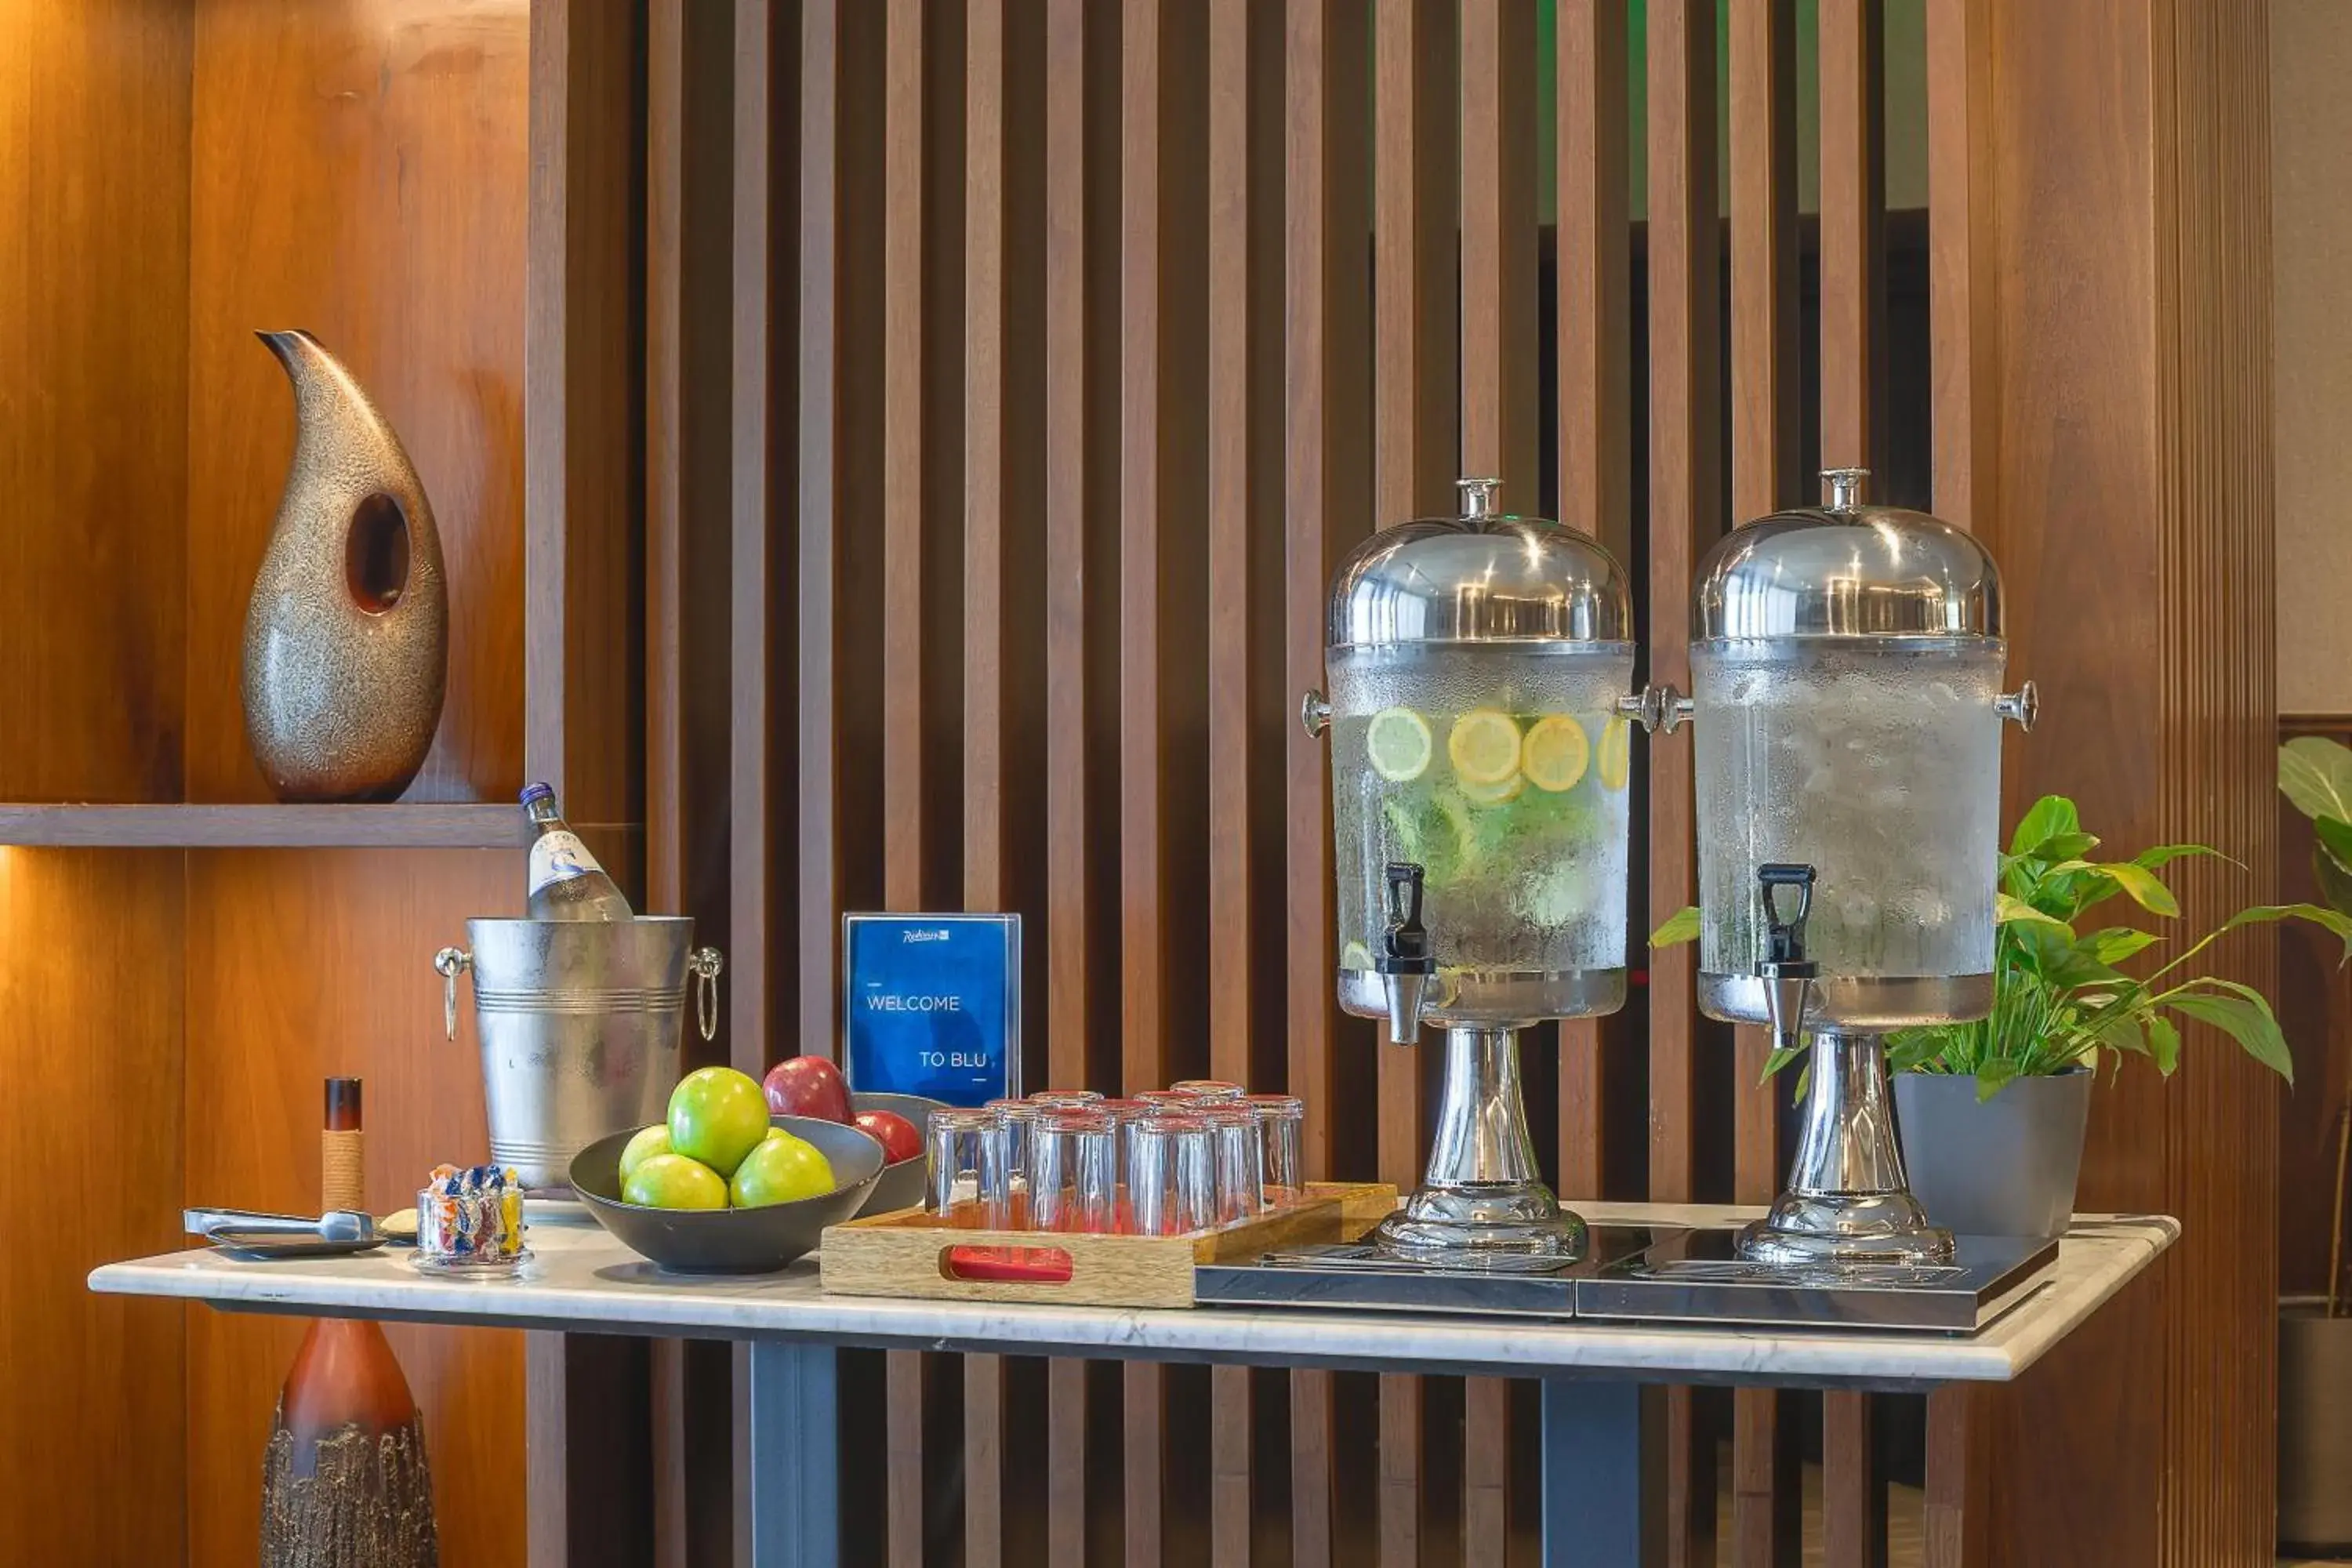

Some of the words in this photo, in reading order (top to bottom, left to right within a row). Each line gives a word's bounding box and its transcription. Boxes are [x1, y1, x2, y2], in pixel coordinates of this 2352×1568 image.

[867, 995, 960, 1011] WELCOME
[919, 1051, 945, 1067] TO
[950, 1051, 986, 1067] BLU
